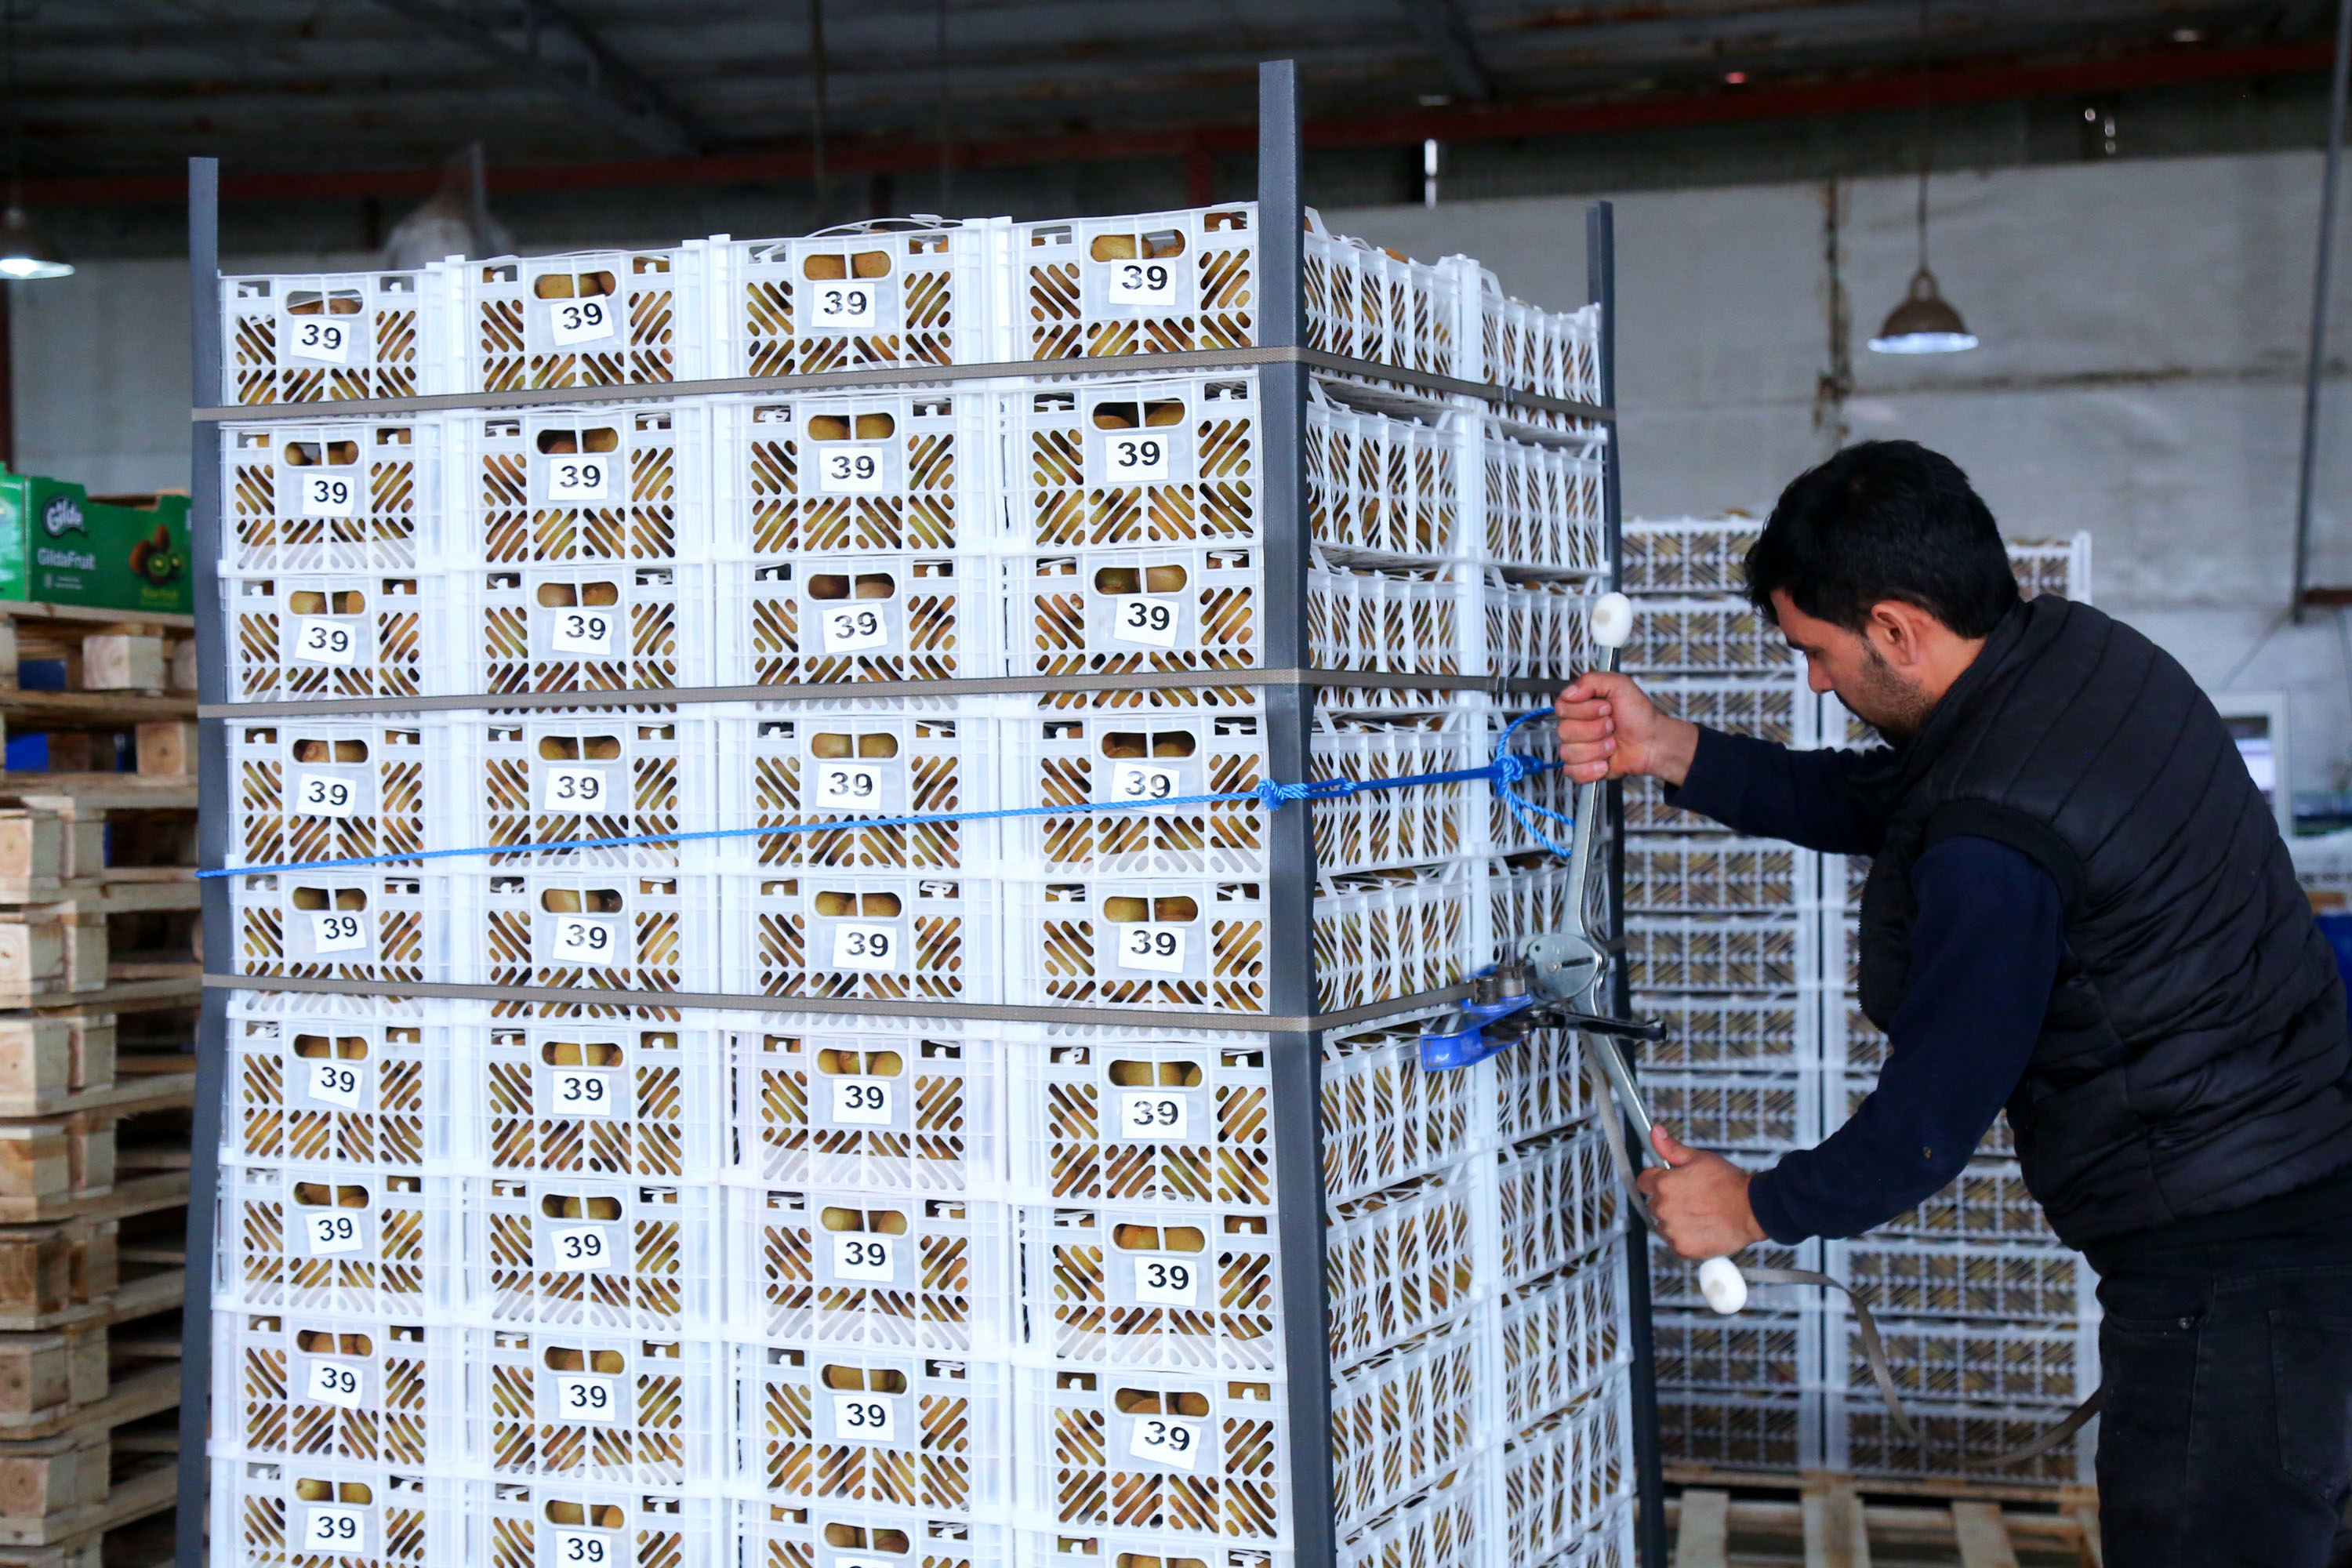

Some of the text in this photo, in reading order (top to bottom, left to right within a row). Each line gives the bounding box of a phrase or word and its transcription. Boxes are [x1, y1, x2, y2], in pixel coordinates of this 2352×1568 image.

[1121, 264, 1168, 291] 39
[561, 302, 604, 330] 39
[822, 290, 867, 316] 39
[301, 323, 342, 350] 39
[1117, 441, 1161, 467] 39
[559, 464, 601, 488] 39
[830, 455, 876, 480] 39
[313, 480, 348, 505] 39
[37, 547, 96, 571] GildaFruit
[565, 615, 607, 641] 39
[833, 611, 878, 639] 39
[1127, 601, 1171, 631] 39
[307, 626, 349, 653] 39
[307, 780, 349, 807] 39
[556, 775, 600, 800] 39
[829, 771, 873, 797] 39
[1125, 769, 1171, 800] 39
[322, 916, 358, 941] 39
[565, 924, 608, 950] 39
[846, 931, 889, 958] 39
[1130, 929, 1177, 957] 39
[320, 1065, 356, 1094] 39
[563, 1077, 604, 1102] 39
[844, 1084, 884, 1110] 39
[1133, 1100, 1179, 1127] 39
[318, 1217, 354, 1243] 39
[563, 1233, 601, 1259] 39
[844, 1241, 887, 1268] 39
[1147, 1263, 1189, 1291] 39
[320, 1367, 357, 1395] 39
[570, 1384, 608, 1409] 39
[846, 1403, 887, 1428] 39
[1144, 1421, 1191, 1452] 39
[315, 1515, 357, 1540] 39
[567, 1537, 604, 1563] 39
